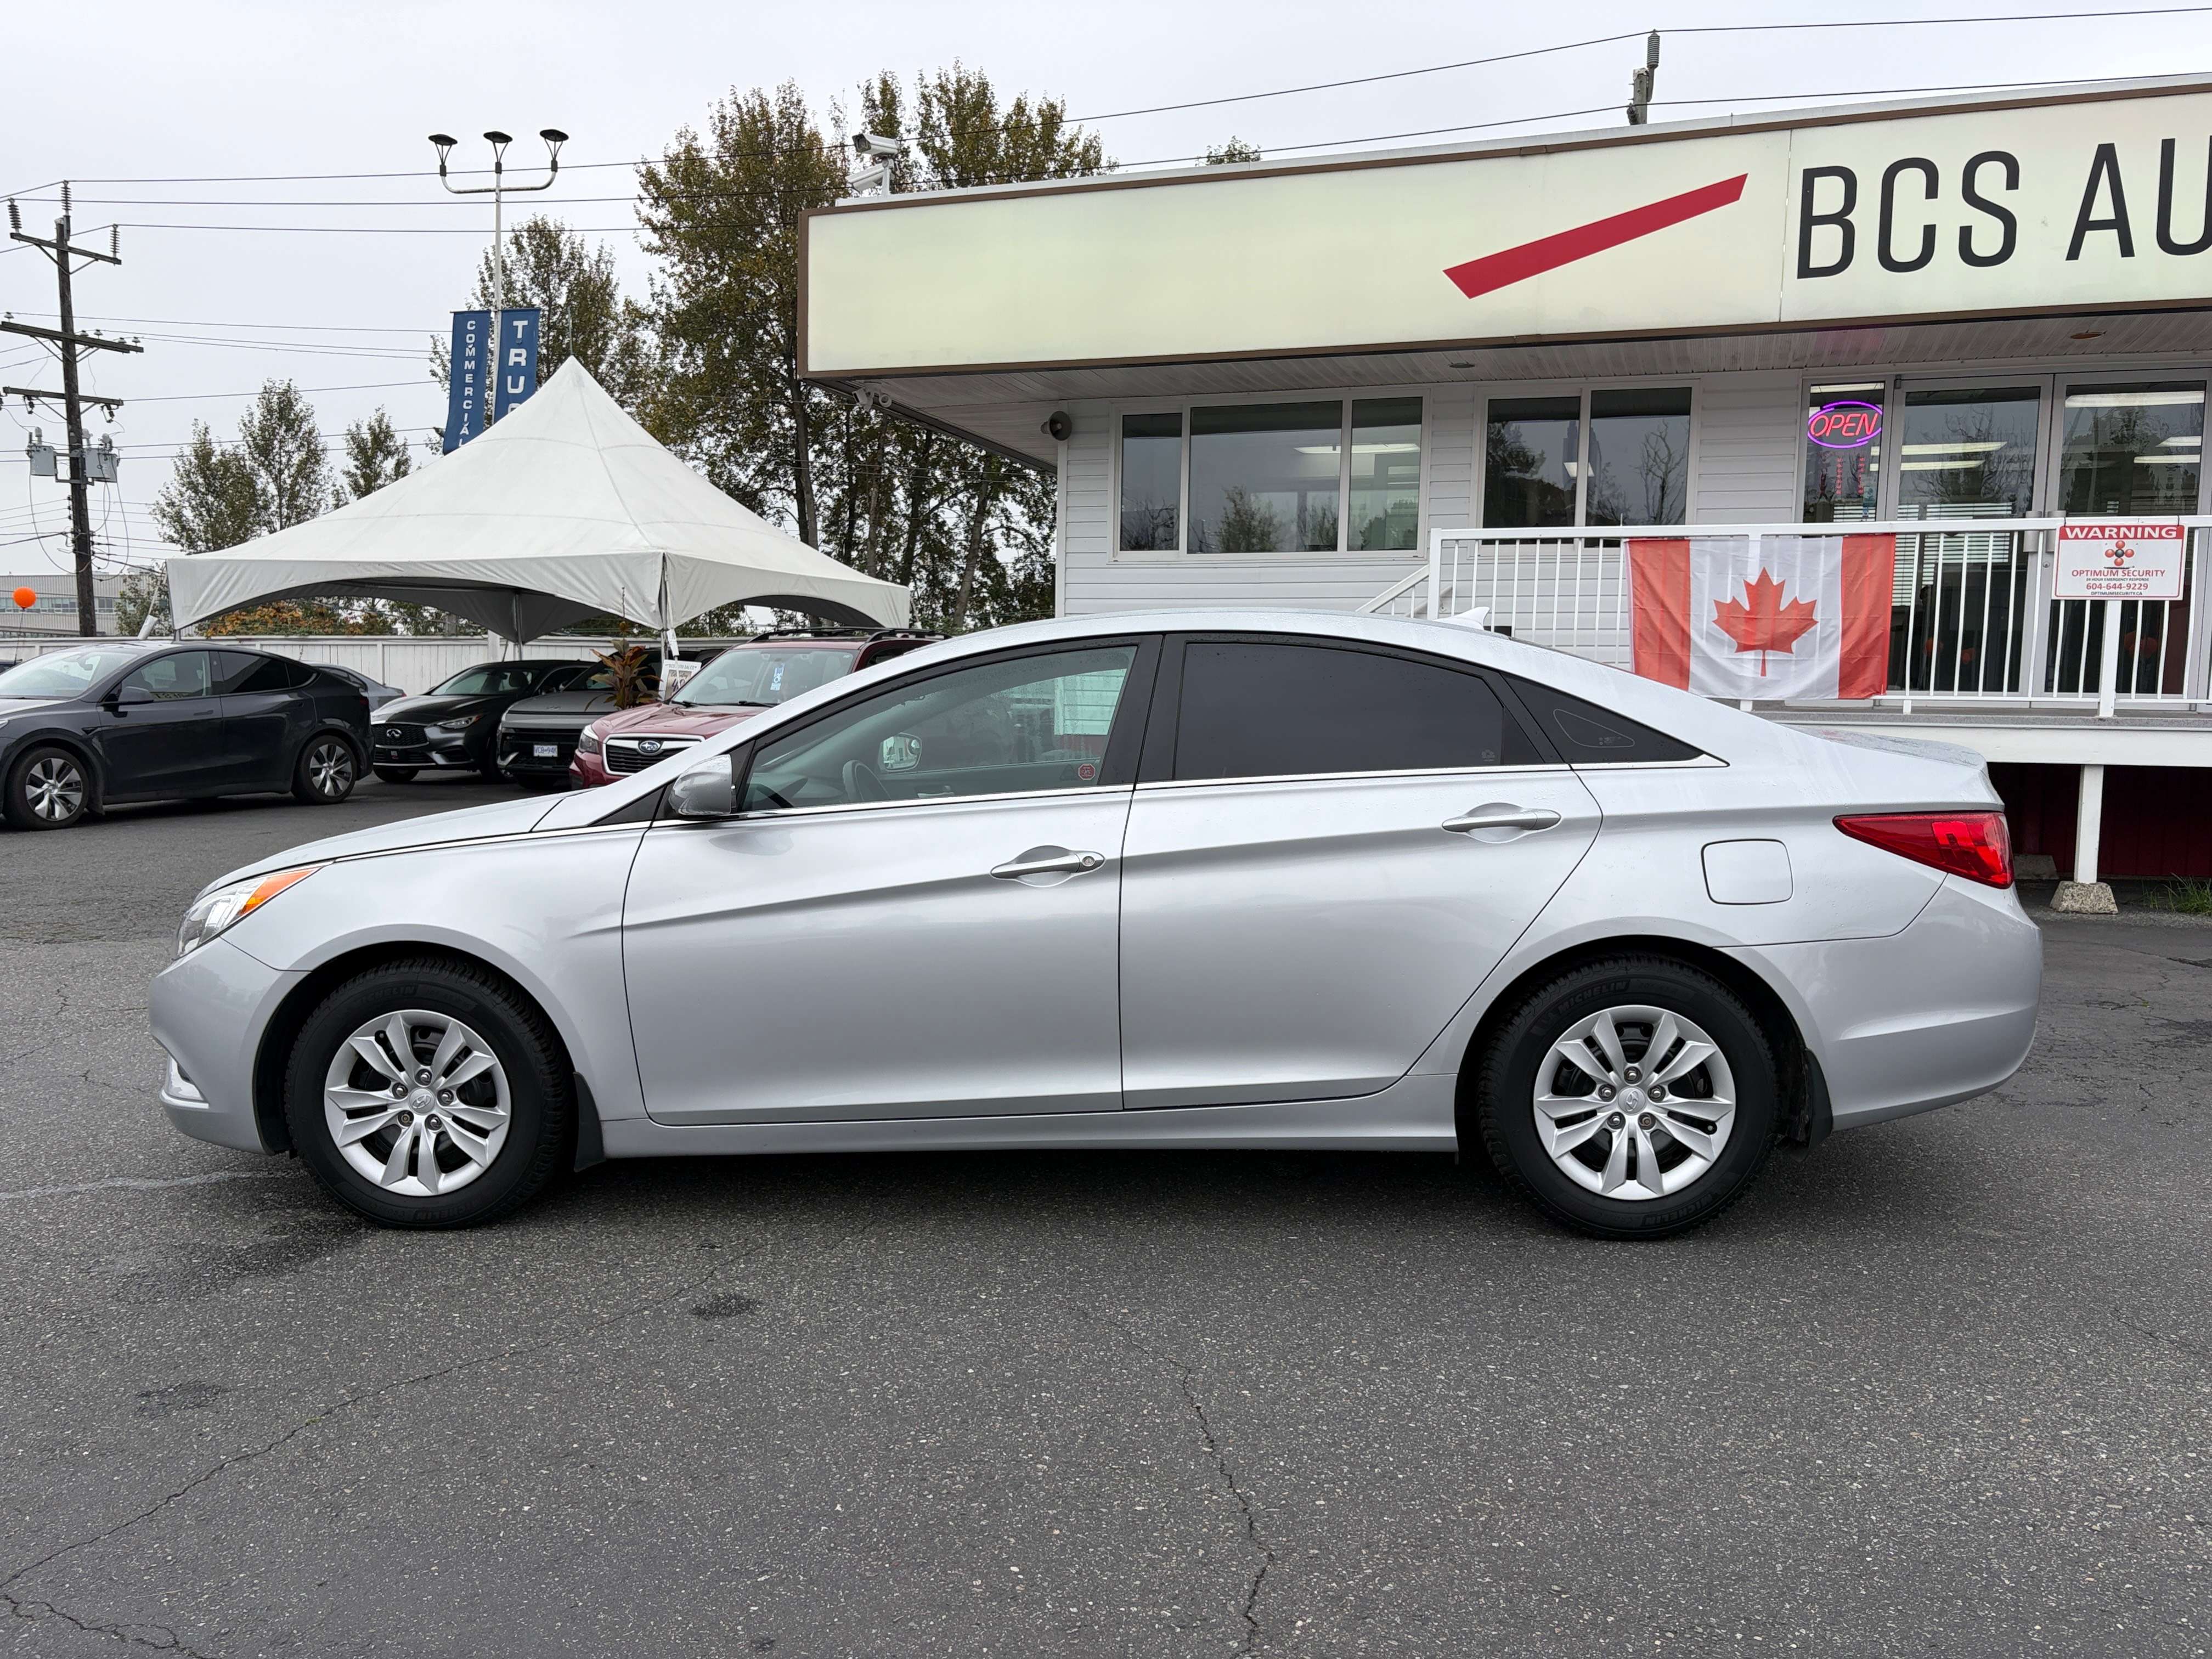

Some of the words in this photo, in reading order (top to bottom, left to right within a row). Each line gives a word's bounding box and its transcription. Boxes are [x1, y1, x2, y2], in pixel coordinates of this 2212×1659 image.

[1797, 151, 2020, 280] BCS
[2065, 136, 2212, 261] AU
[458, 320, 476, 447] COMMERCIAL
[1810, 413, 1878, 437] OPEN
[2066, 526, 2177, 539] WARNING
[2072, 569, 2118, 577] OPTIMUM
[2121, 569, 2165, 577] SECURITY
[1558, 979, 1628, 1014] MICHELIN
